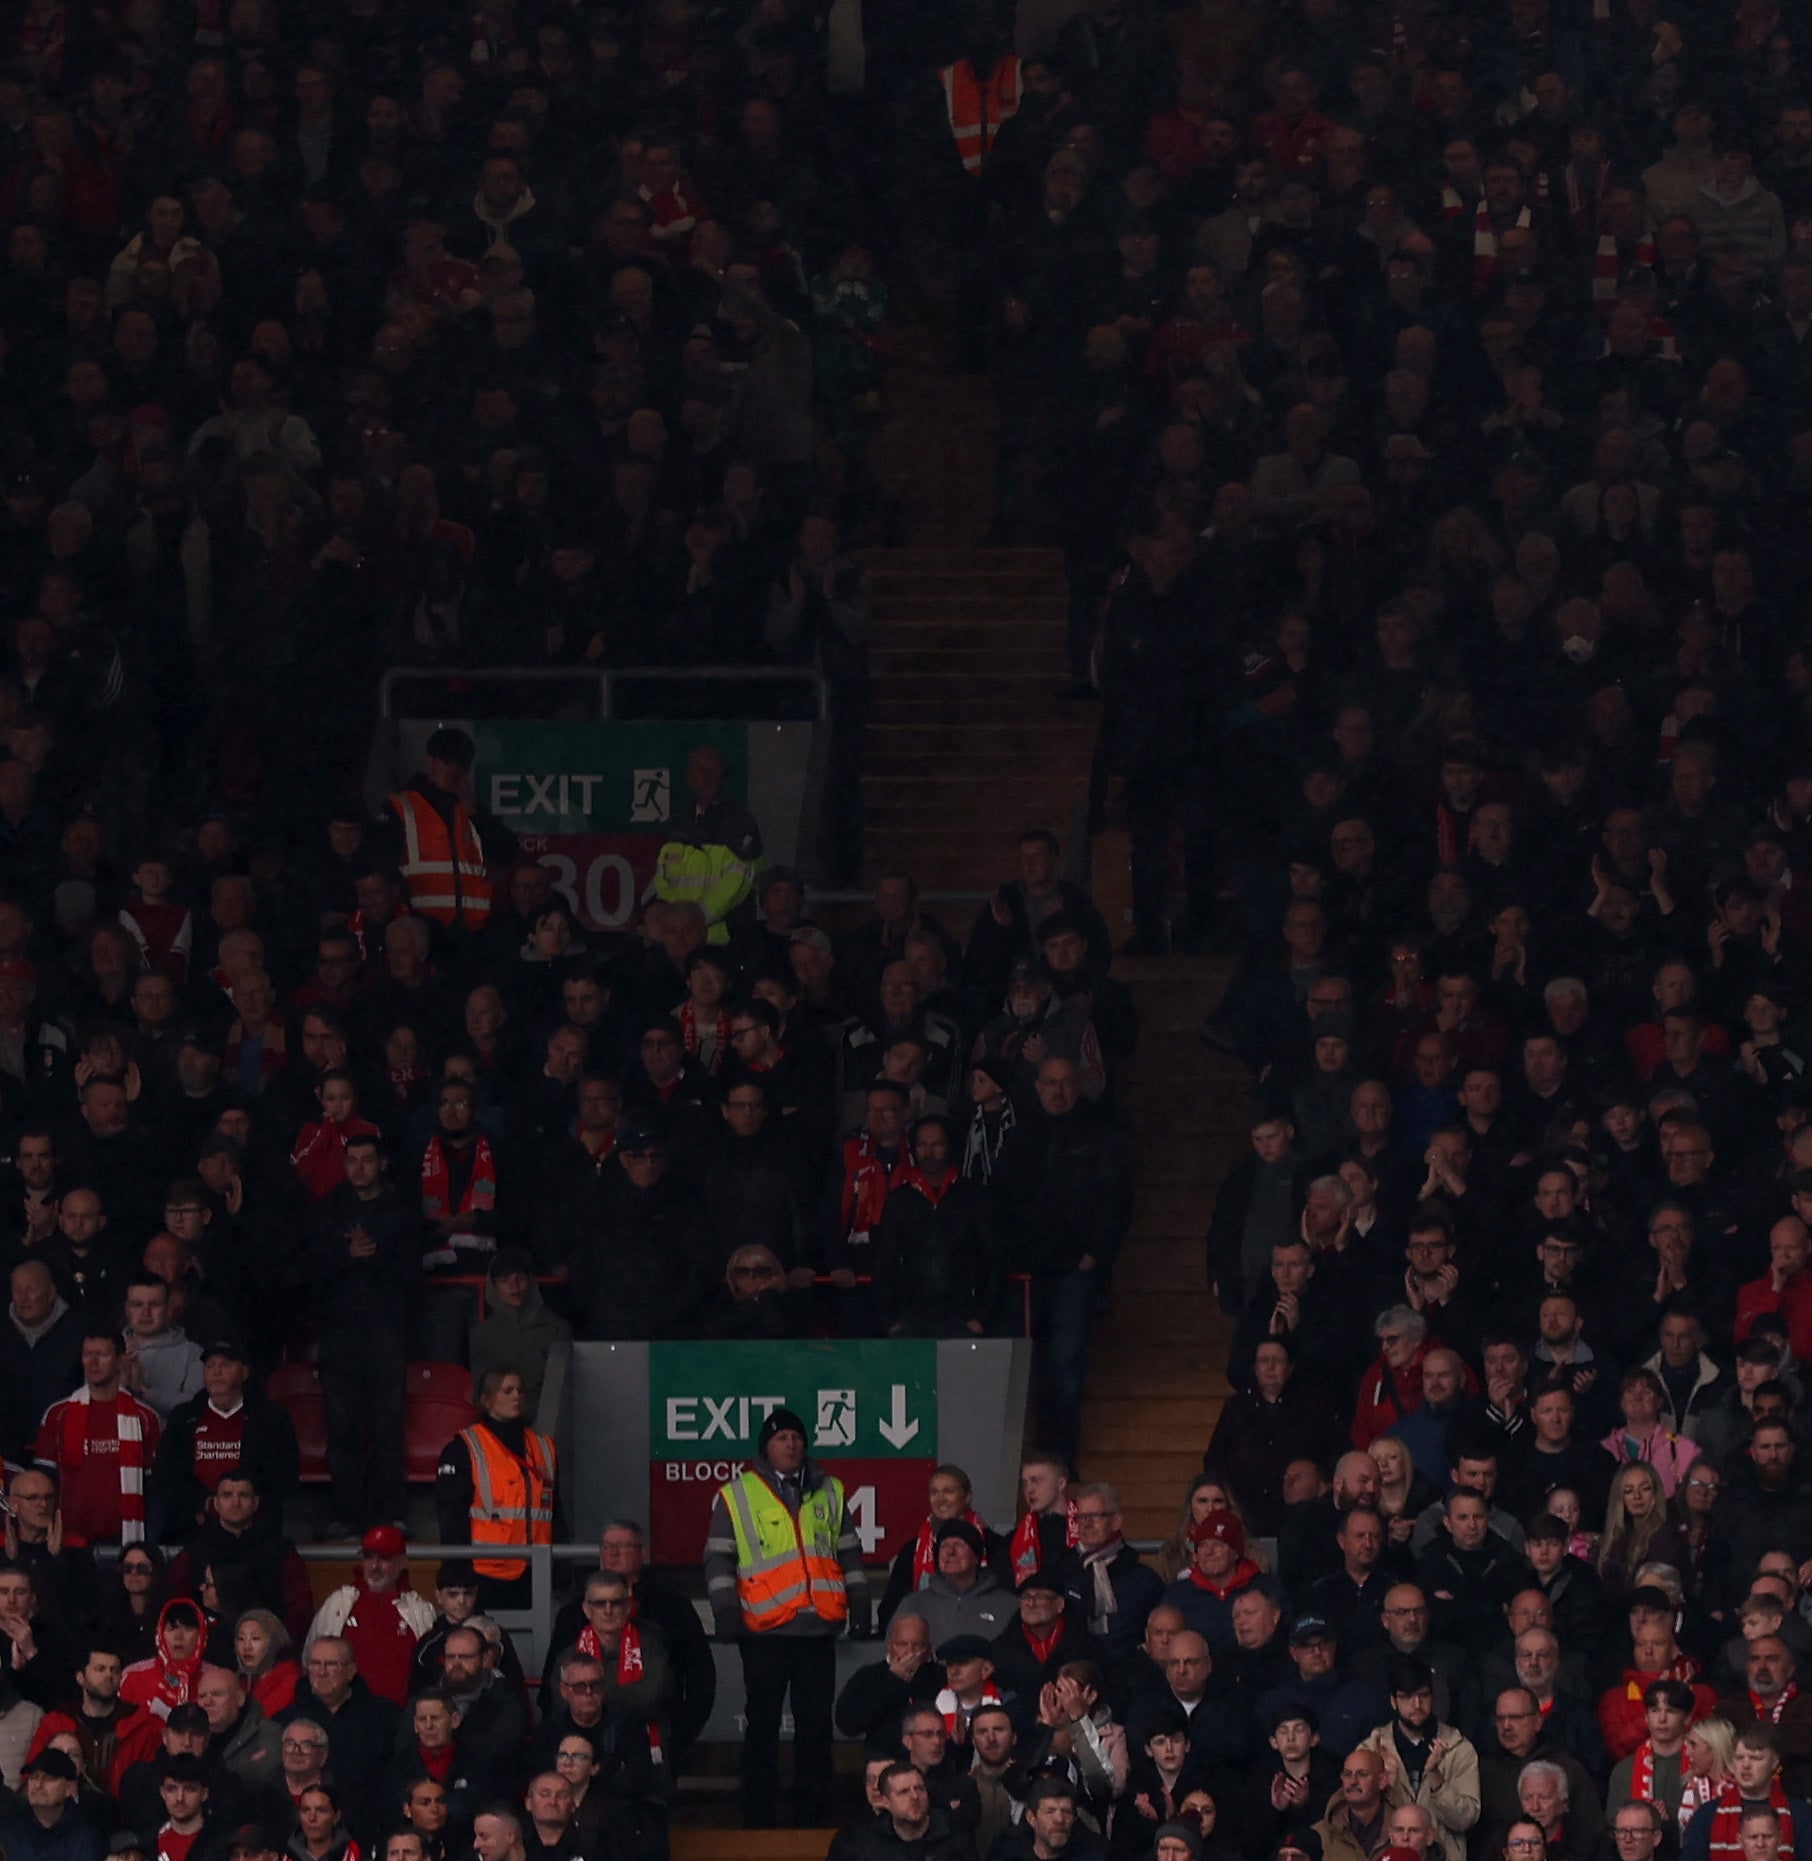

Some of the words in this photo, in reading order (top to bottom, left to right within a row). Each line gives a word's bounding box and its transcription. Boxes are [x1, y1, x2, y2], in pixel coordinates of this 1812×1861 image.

[491, 774, 603, 815] EXIT
[537, 853, 656, 926] 30
[665, 1396, 786, 1440] EXIT
[665, 1461, 746, 1481] BLOCK
